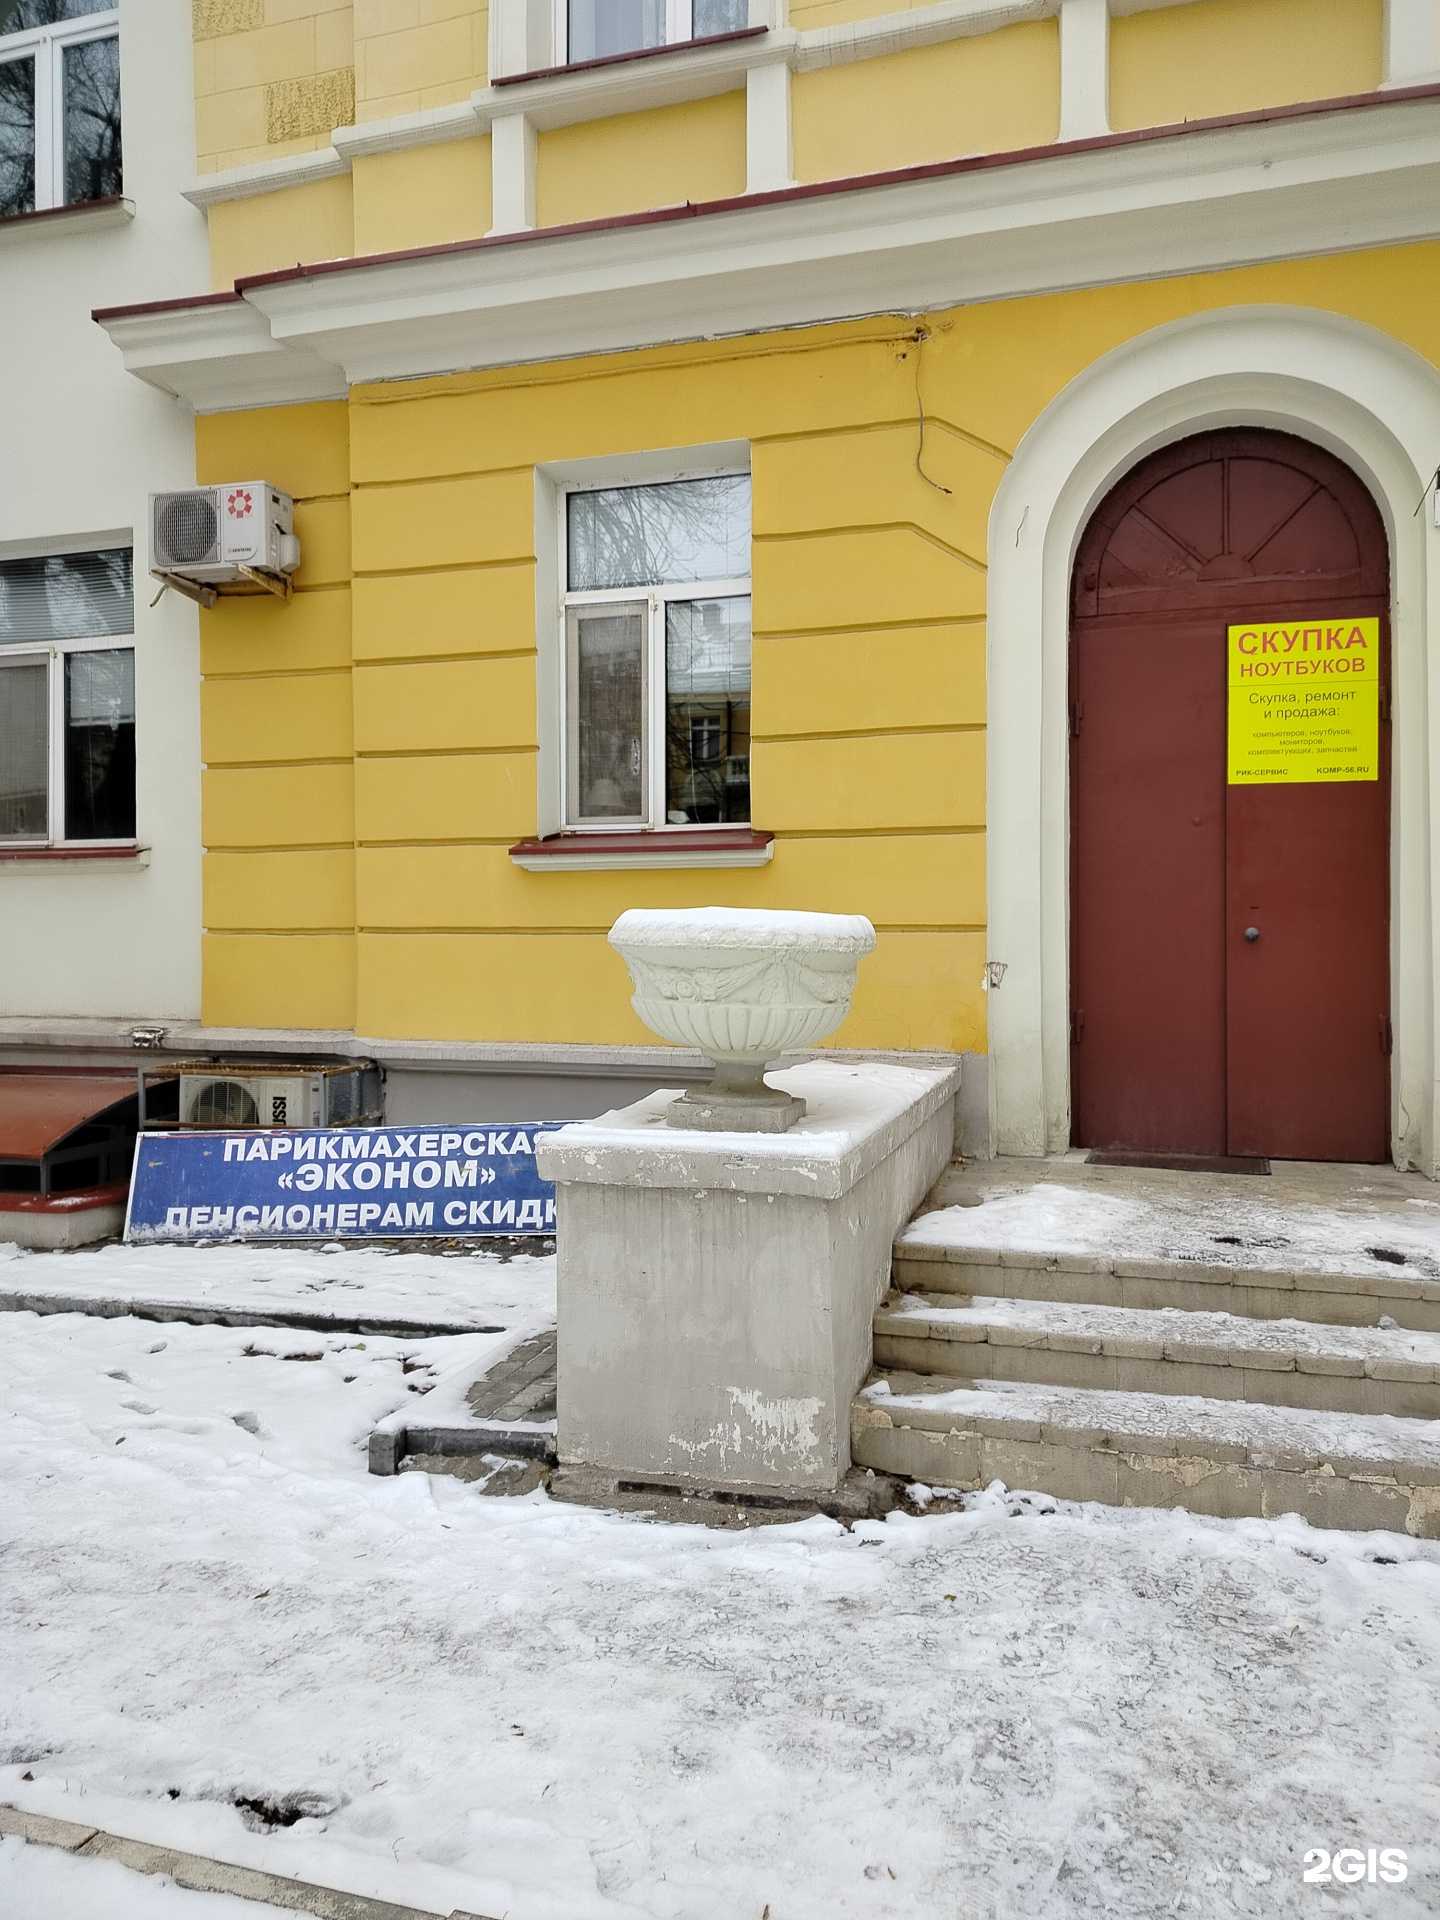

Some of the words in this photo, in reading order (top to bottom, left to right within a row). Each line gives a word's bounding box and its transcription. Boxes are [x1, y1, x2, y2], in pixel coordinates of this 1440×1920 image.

[1238, 626, 1368, 655] СКУПКА
[1240, 657, 1365, 678] НОУТБУКОВ
[1249, 692, 1300, 705] Скупка,
[1305, 690, 1357, 704] ремонт
[1264, 710, 1271, 719] и
[1276, 708, 1341, 720] продажа:
[1236, 768, 1288, 776] РИК-СЕРВИС
[223, 1131, 537, 1161] ПАРИКМАХЕРСКА
[277, 1160, 496, 1192] «ЭКОНОМ»
[165, 1201, 437, 1230] ПЕНСИОНЕРАМ
